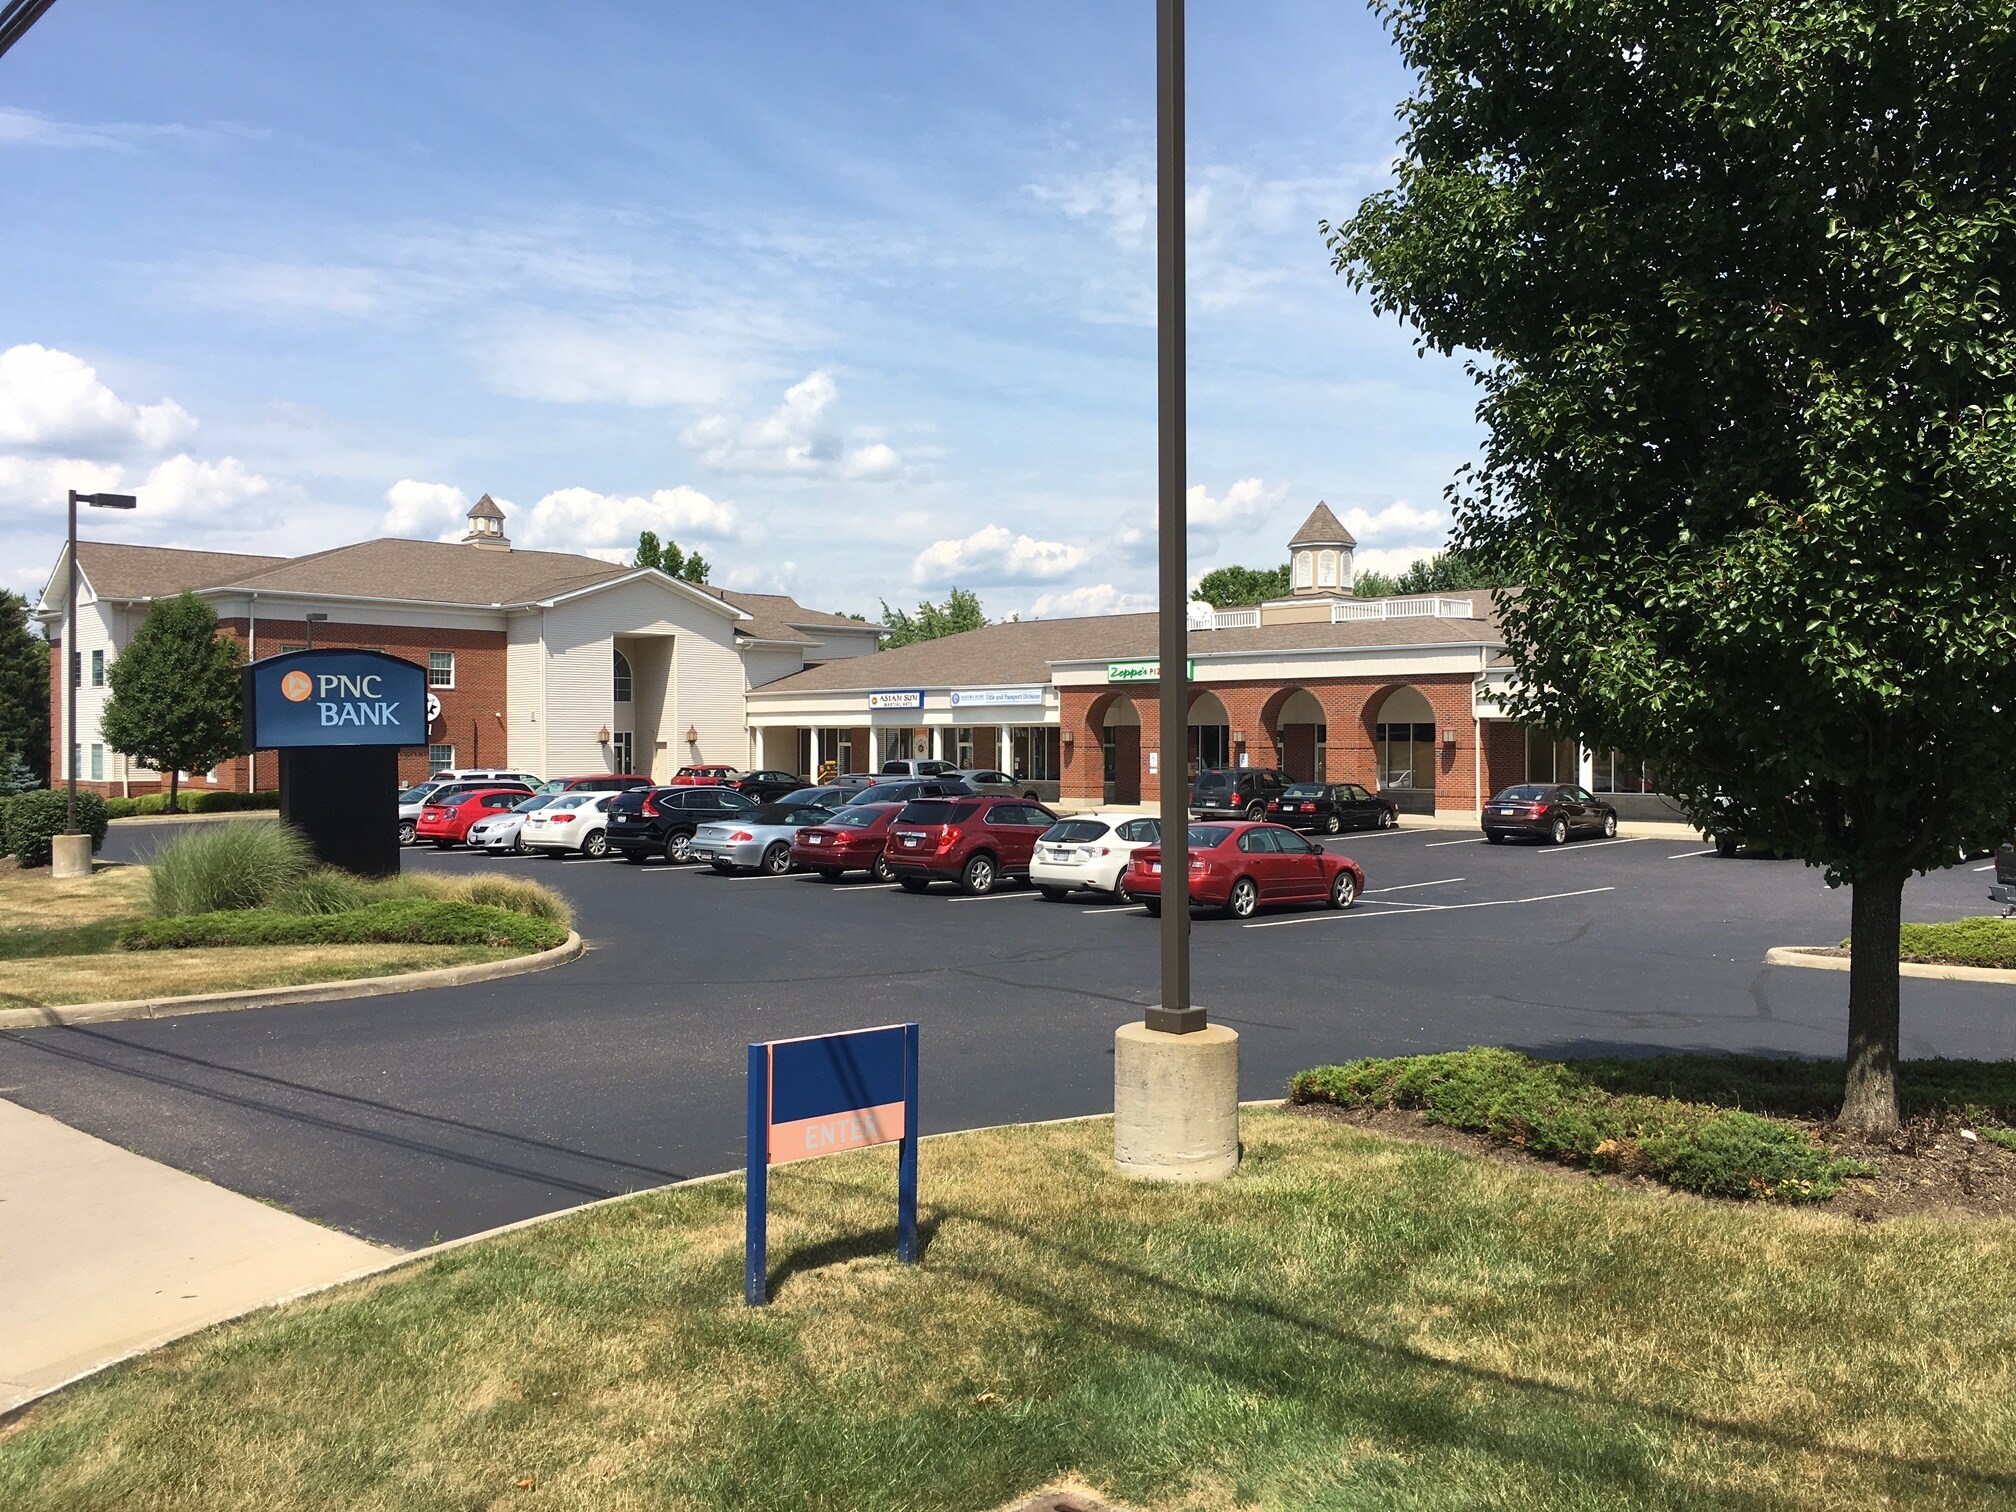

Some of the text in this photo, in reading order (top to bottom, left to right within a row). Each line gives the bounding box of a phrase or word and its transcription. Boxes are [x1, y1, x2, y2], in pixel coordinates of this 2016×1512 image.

[1110, 667, 1148, 678] Zeppe's
[316, 674, 382, 698] PNC
[316, 702, 400, 726] BANK
[805, 1114, 878, 1150] ENTER
